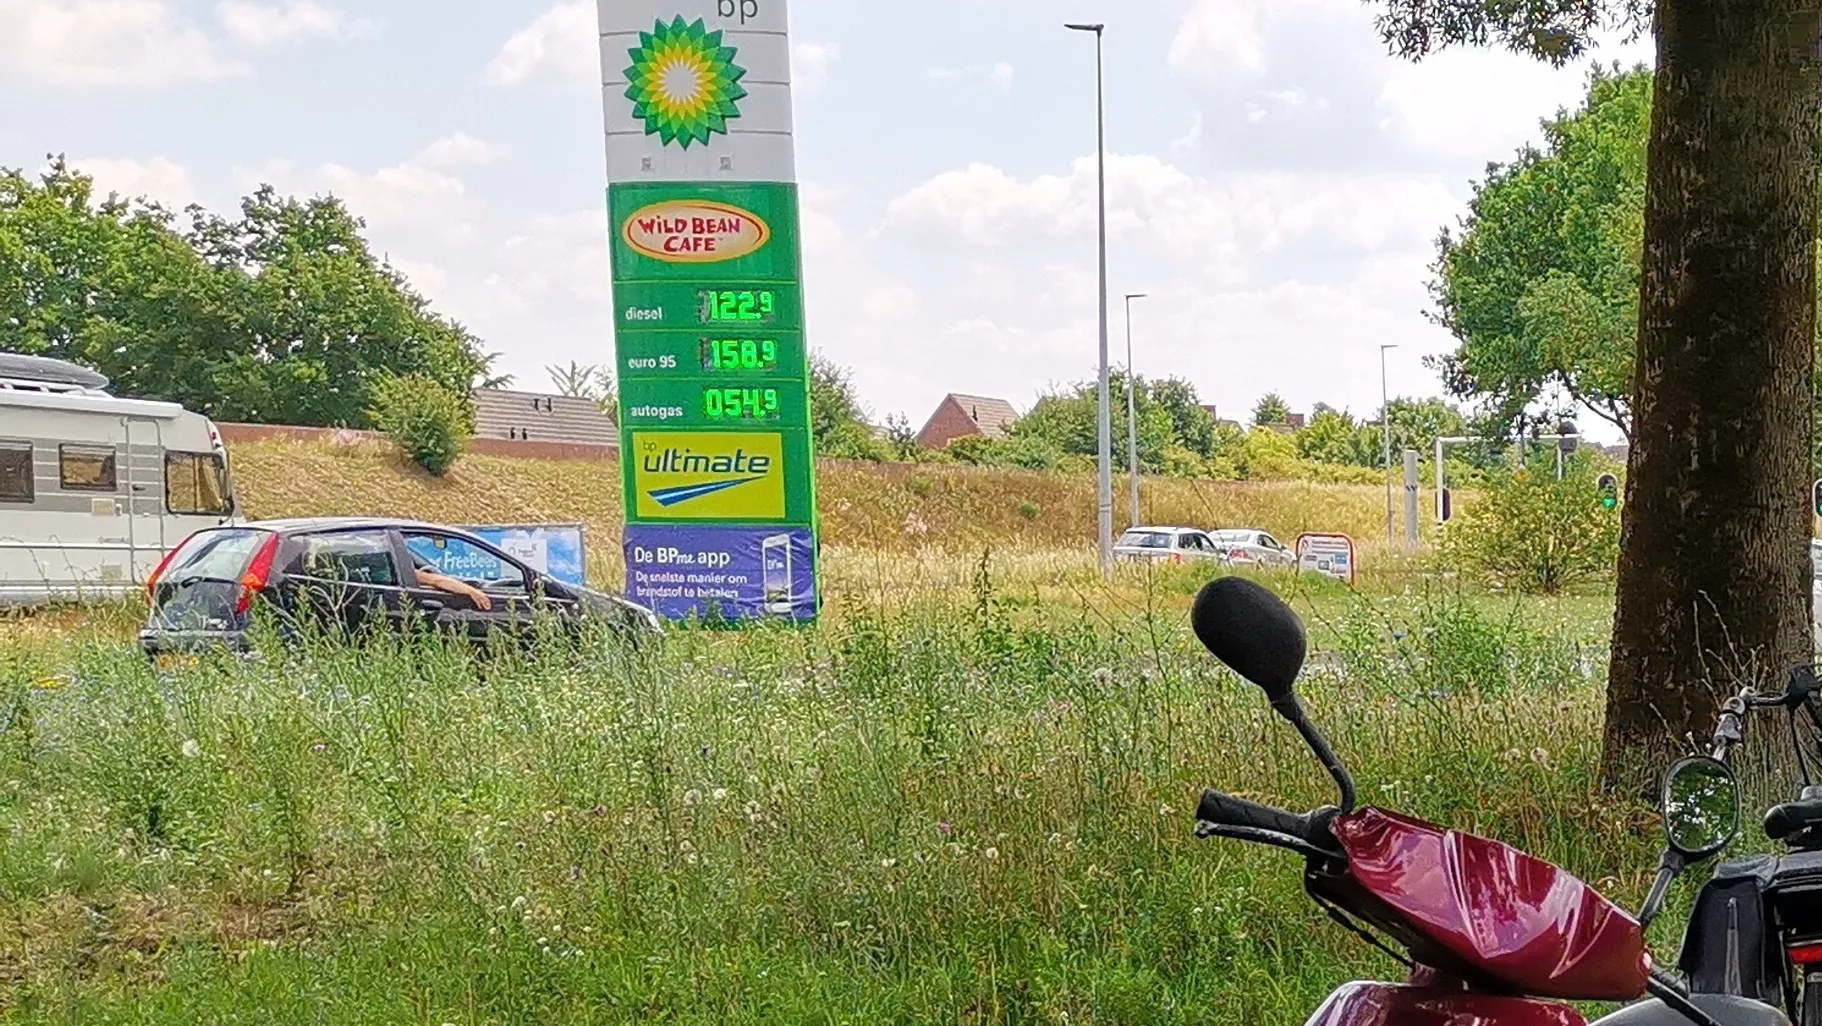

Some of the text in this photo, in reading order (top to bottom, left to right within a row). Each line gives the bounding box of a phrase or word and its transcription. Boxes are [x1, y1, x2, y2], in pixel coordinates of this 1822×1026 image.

[718, 0, 758, 25] bp
[692, 217, 740, 234] BEAN
[663, 236, 716, 252] CAFE
[625, 307, 662, 320] diesel
[628, 357, 656, 368] euro
[659, 355, 676, 368] 95
[631, 405, 683, 420] autogas
[644, 448, 770, 473] ultimate
[634, 546, 653, 563] De
[698, 551, 731, 568] app
[687, 572, 725, 583] manier
[727, 576, 747, 584] om
